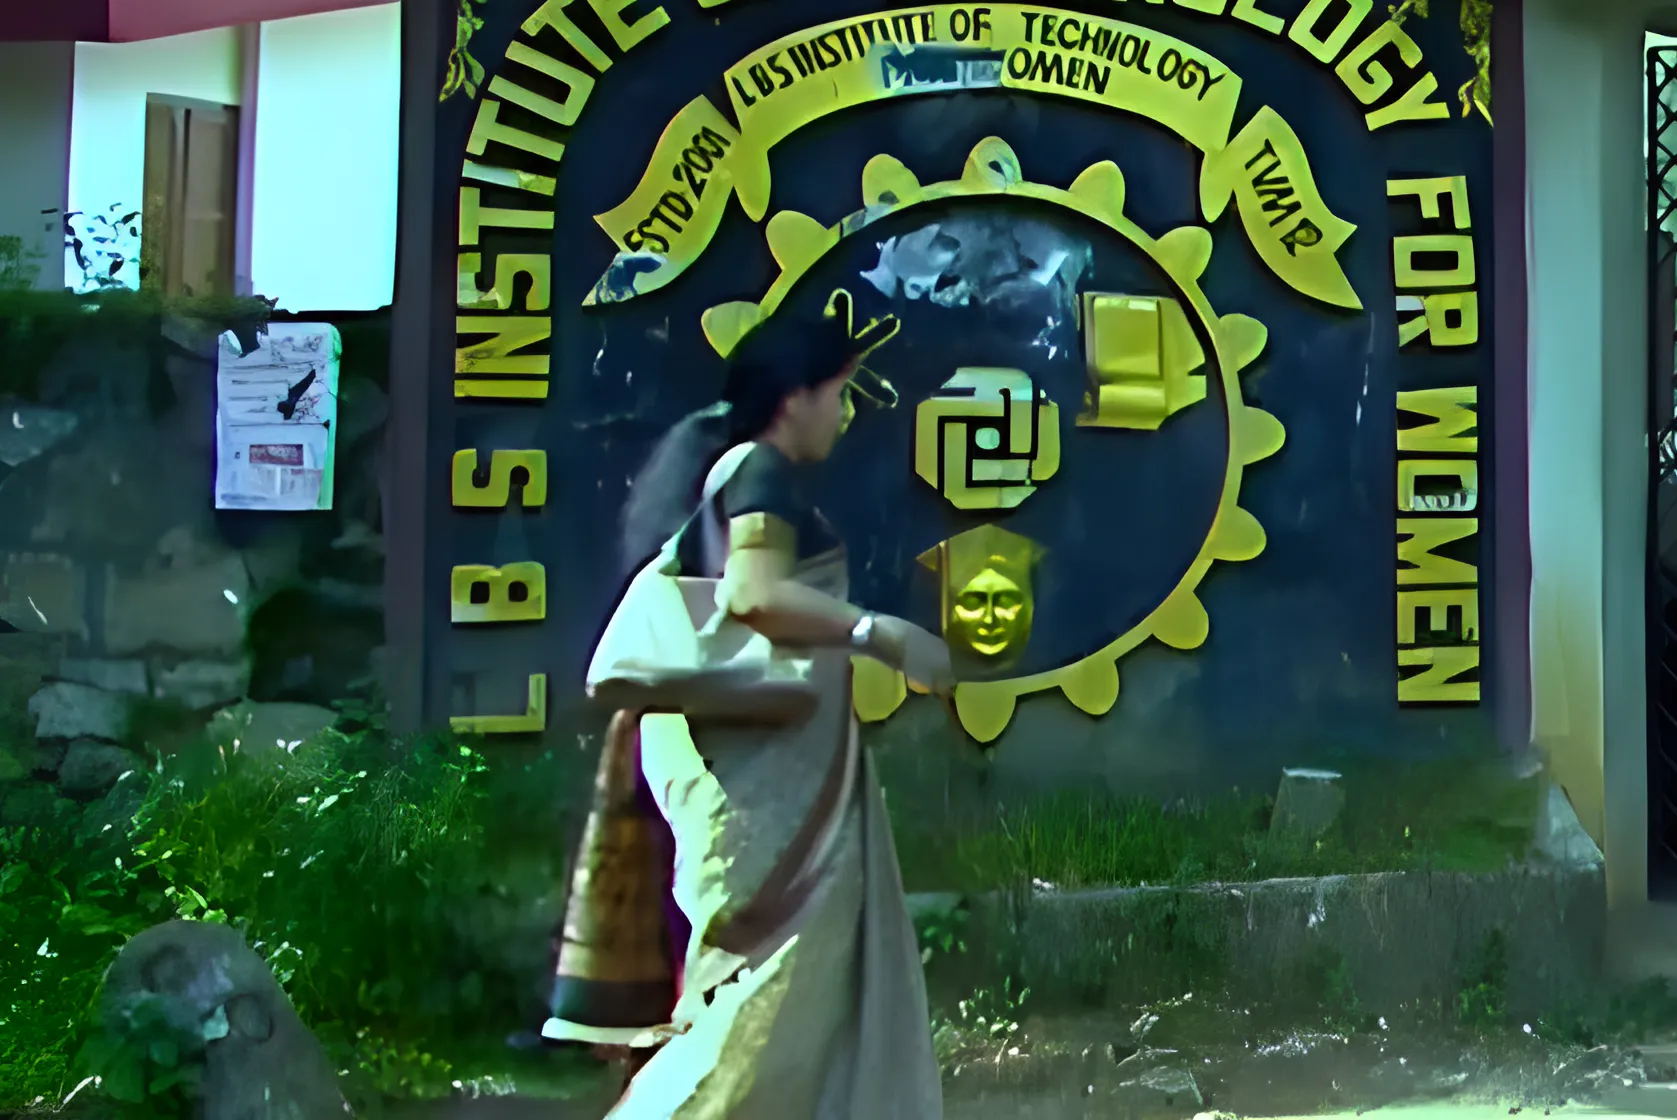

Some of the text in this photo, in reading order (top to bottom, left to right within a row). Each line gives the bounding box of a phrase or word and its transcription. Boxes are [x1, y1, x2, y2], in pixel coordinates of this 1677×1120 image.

[787, 11, 938, 78] INSTITUTE
[950, 9, 992, 42] OF
[1020, 11, 1227, 101] TECHNOLOGY
[1006, 46, 1111, 95] OMEN
[1244, 138, 1303, 228] TVM
[1386, 175, 1479, 348] FOR
[1396, 385, 1481, 702] WOMEN
